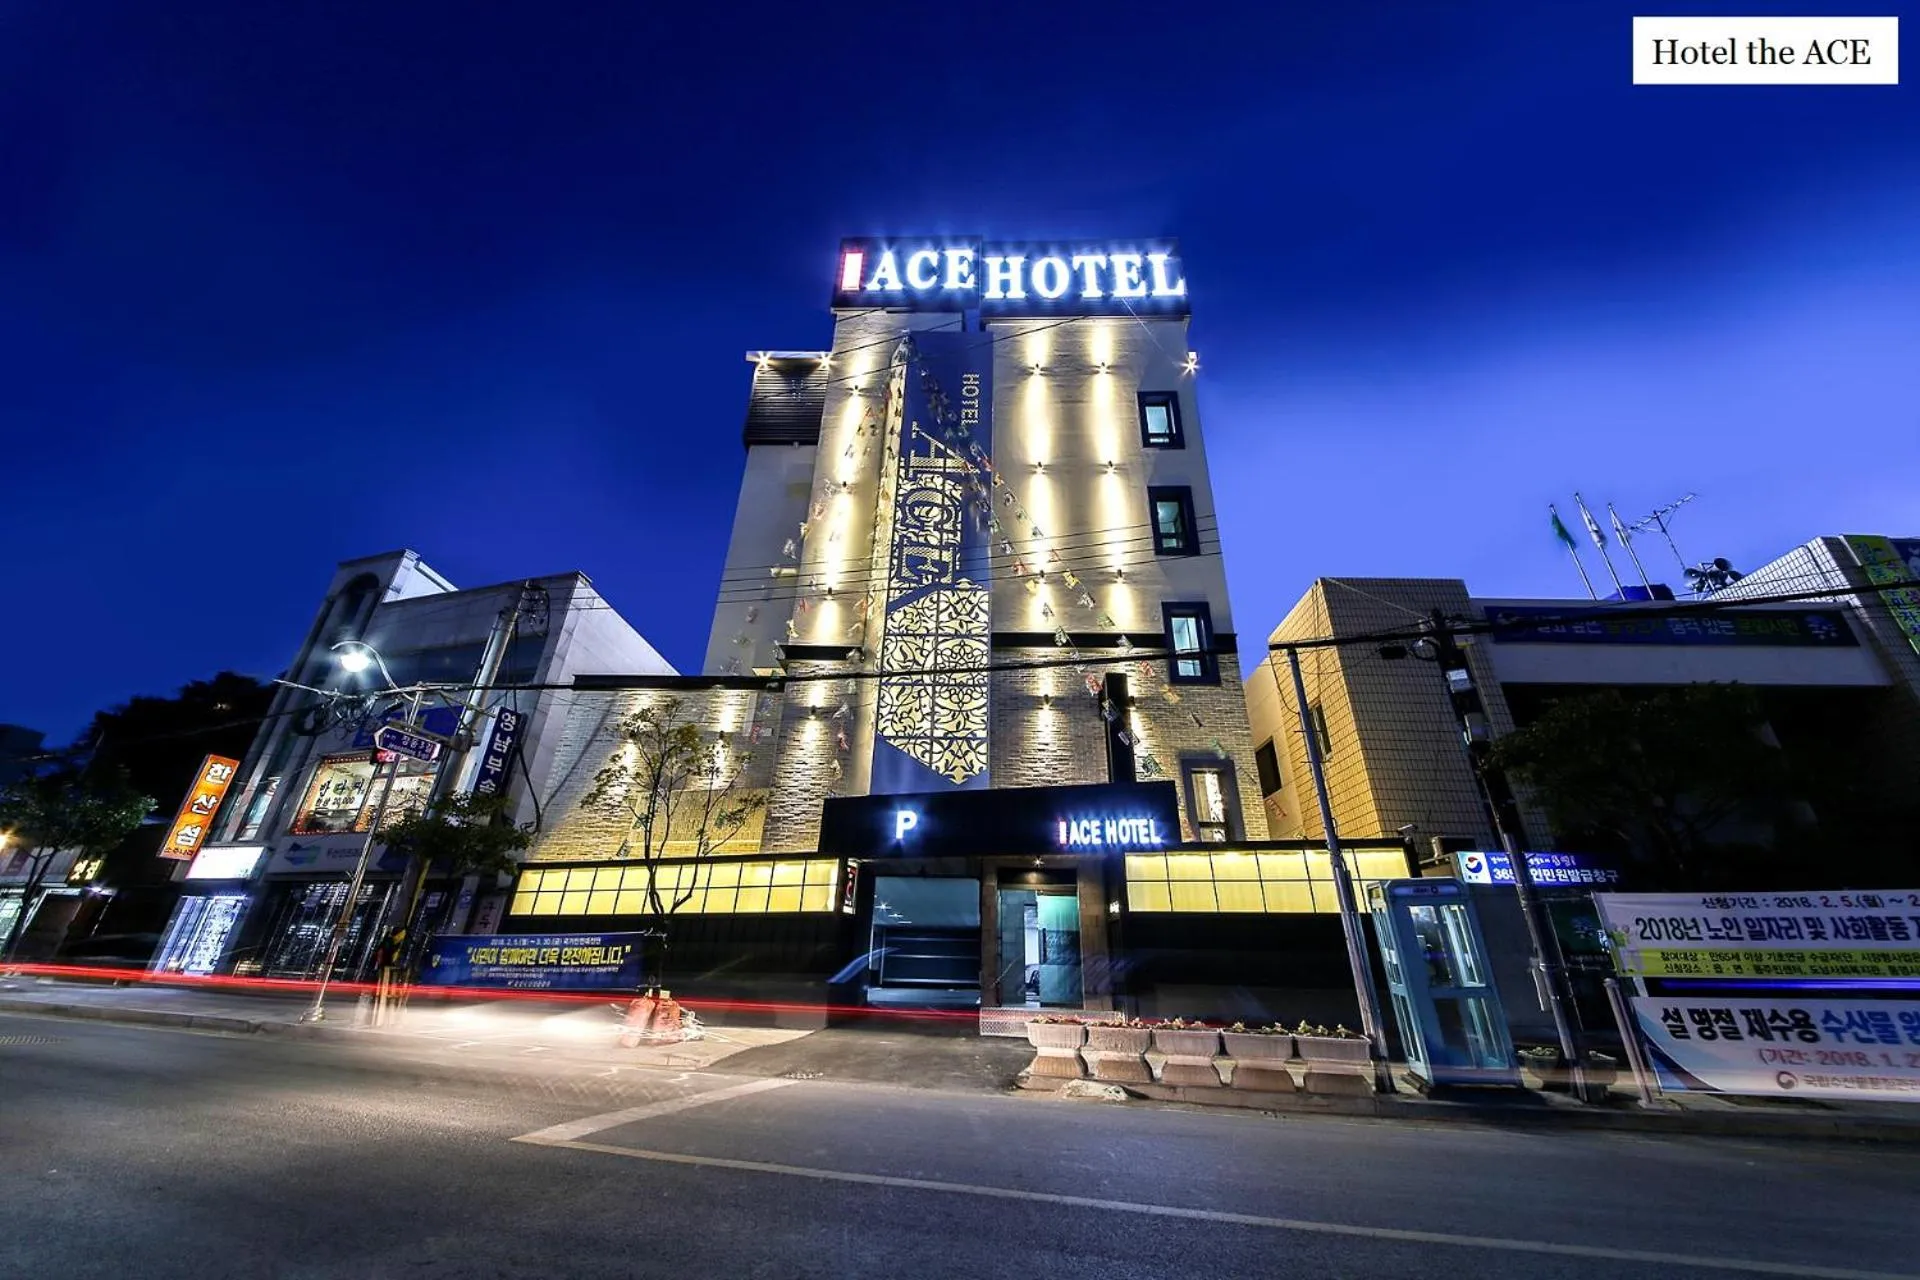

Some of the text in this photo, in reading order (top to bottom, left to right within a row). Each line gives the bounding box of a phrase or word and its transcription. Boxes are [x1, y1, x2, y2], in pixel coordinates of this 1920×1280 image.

[865, 250, 1187, 299] ACE HOTEL
[961, 373, 980, 425] HOTEL
[901, 421, 980, 584] ACE
[176, 762, 232, 847] 한산섬
[895, 810, 918, 839] P
[1069, 818, 1162, 845] ACE HOTEL
[1702, 896, 1760, 909] 신청기간
[1774, 896, 1817, 909] 2018.
[1819, 895, 1838, 909] 2.
[1635, 917, 1704, 941] 2018년
[1702, 916, 1744, 941] 노인
[1744, 916, 1804, 941] 일자리
[1803, 916, 1829, 941] 및
[1830, 915, 1912, 941] 사회활동
[1661, 1007, 1692, 1041] 설
[1687, 1008, 1745, 1042] 명절
[1740, 1008, 1821, 1044] 제수용
[1821, 1009, 1903, 1045] 수산물
